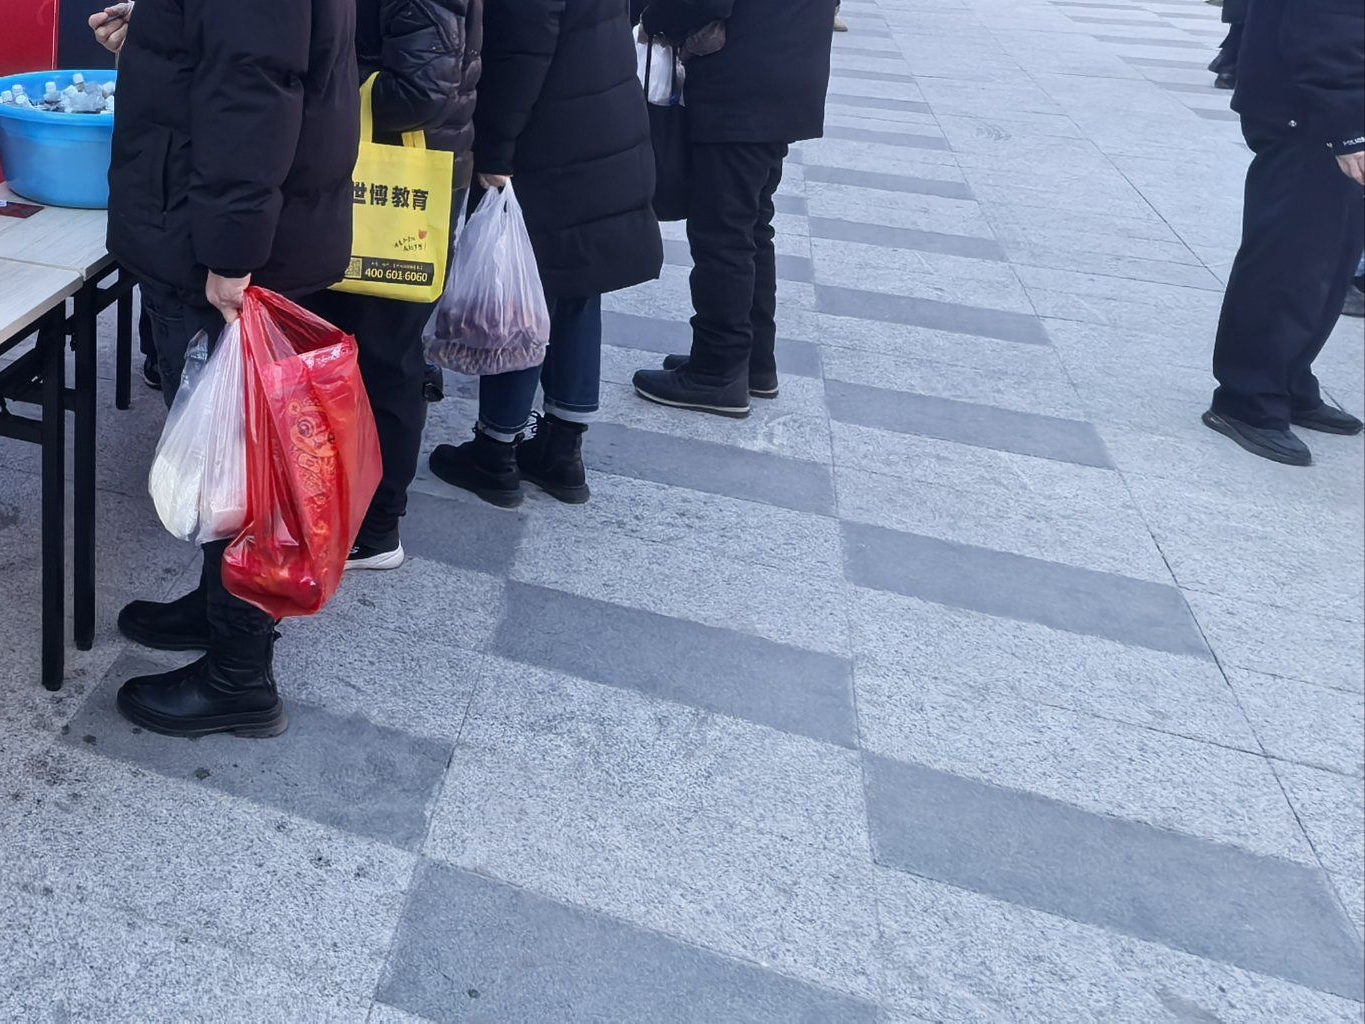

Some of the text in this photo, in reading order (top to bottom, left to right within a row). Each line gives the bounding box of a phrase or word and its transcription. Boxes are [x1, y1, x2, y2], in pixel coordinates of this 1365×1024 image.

[365, 268, 428, 282] 400 601 6060
